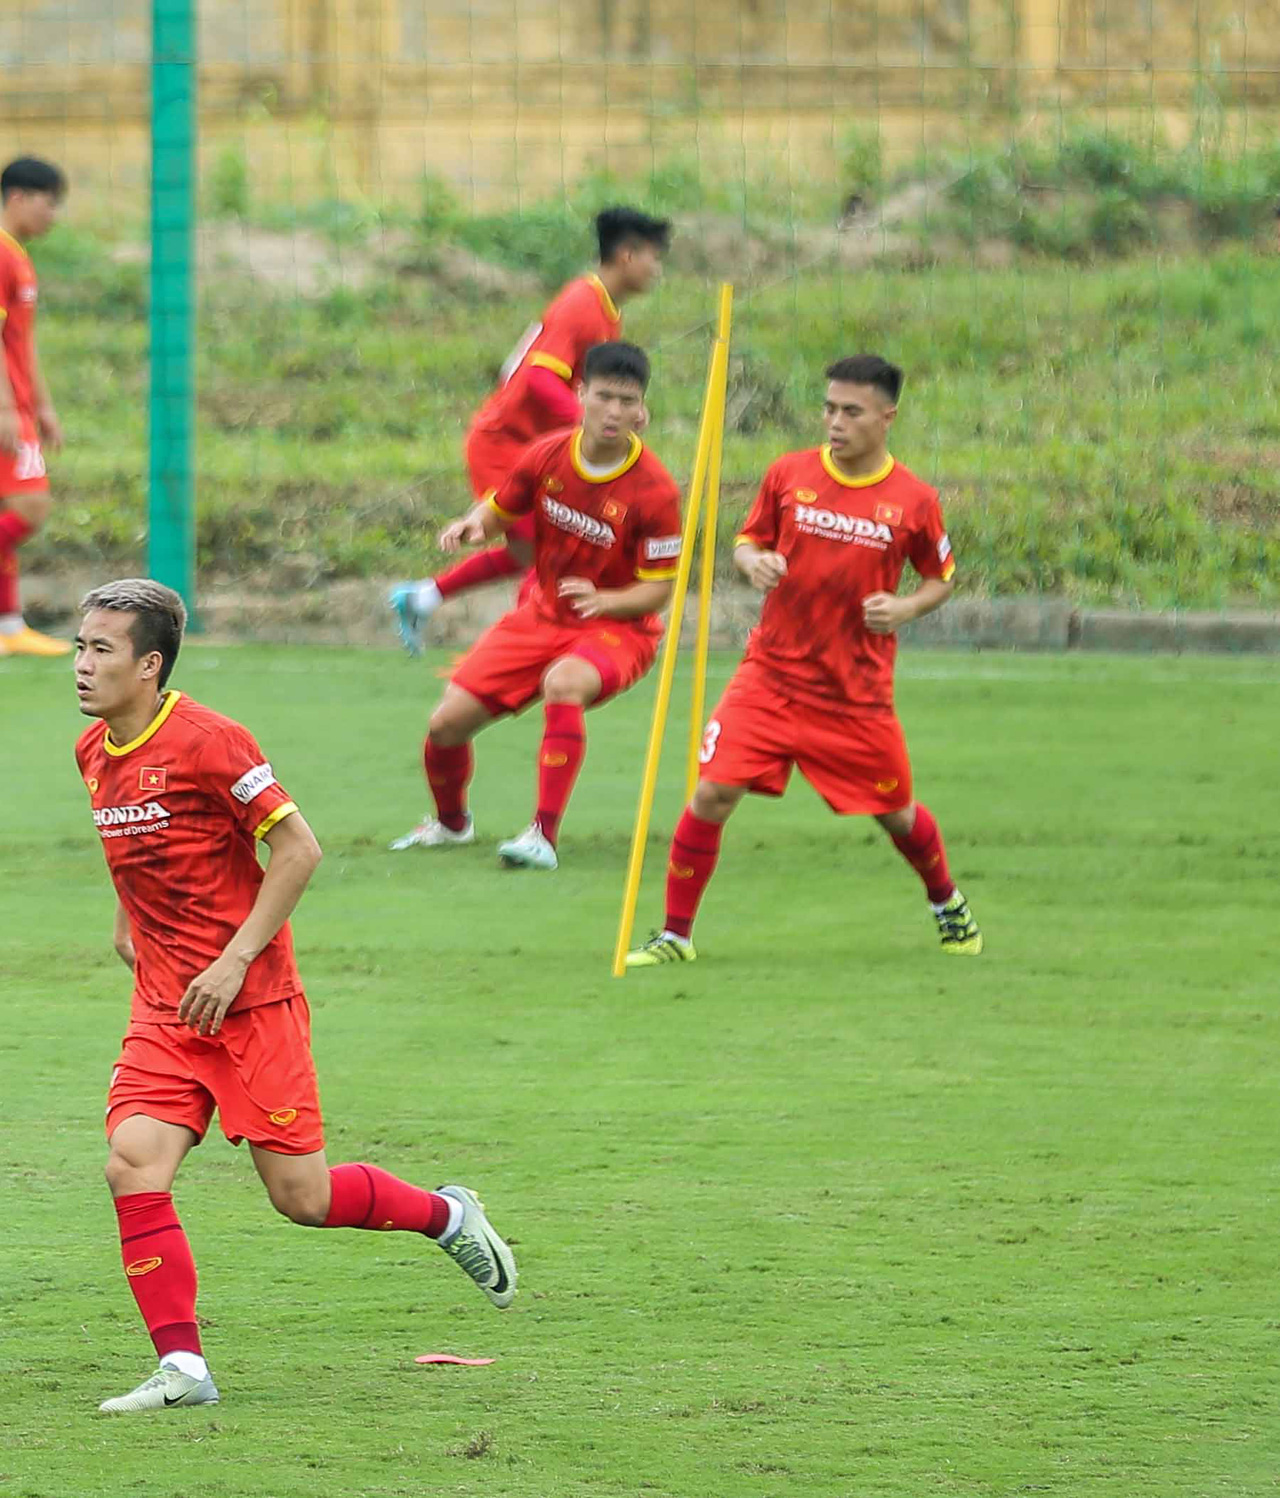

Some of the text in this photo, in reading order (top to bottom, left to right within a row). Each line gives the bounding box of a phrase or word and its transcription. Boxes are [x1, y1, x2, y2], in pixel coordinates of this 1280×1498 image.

[794, 504, 894, 543] HONDA
[92, 802, 171, 827] HONDA
[132, 820, 170, 836] Dreams
